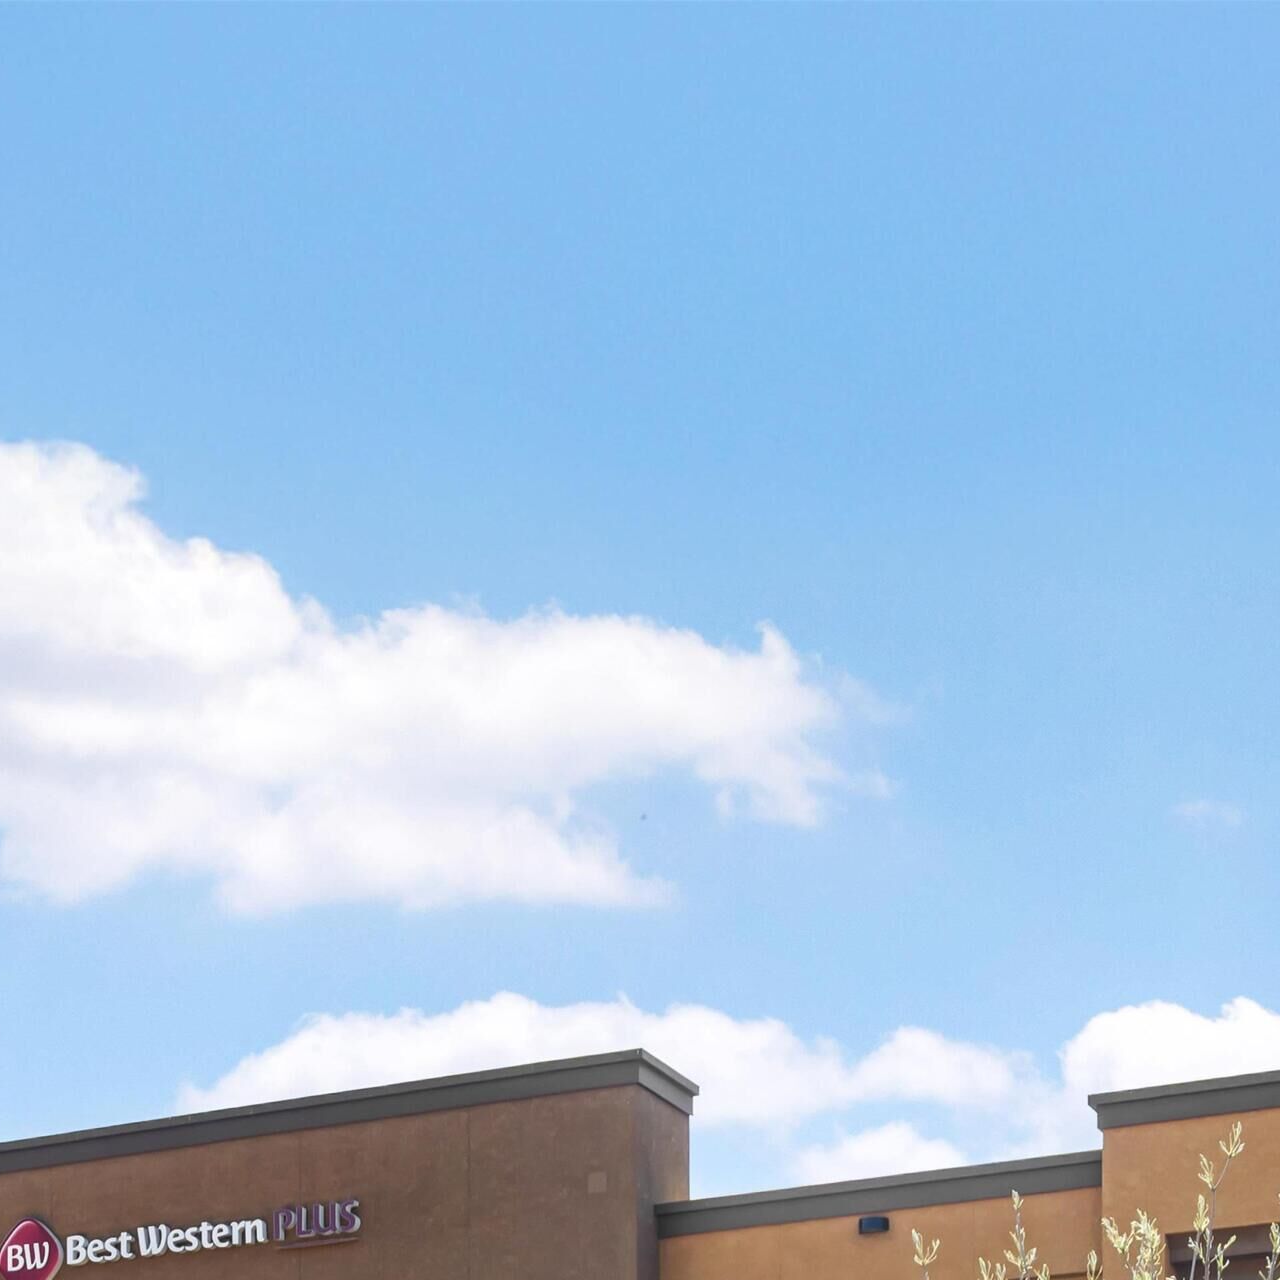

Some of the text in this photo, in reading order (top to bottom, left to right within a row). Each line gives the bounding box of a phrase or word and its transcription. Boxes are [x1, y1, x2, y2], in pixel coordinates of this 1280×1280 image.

[7, 1200, 362, 1272] BW Best Western PLUS
